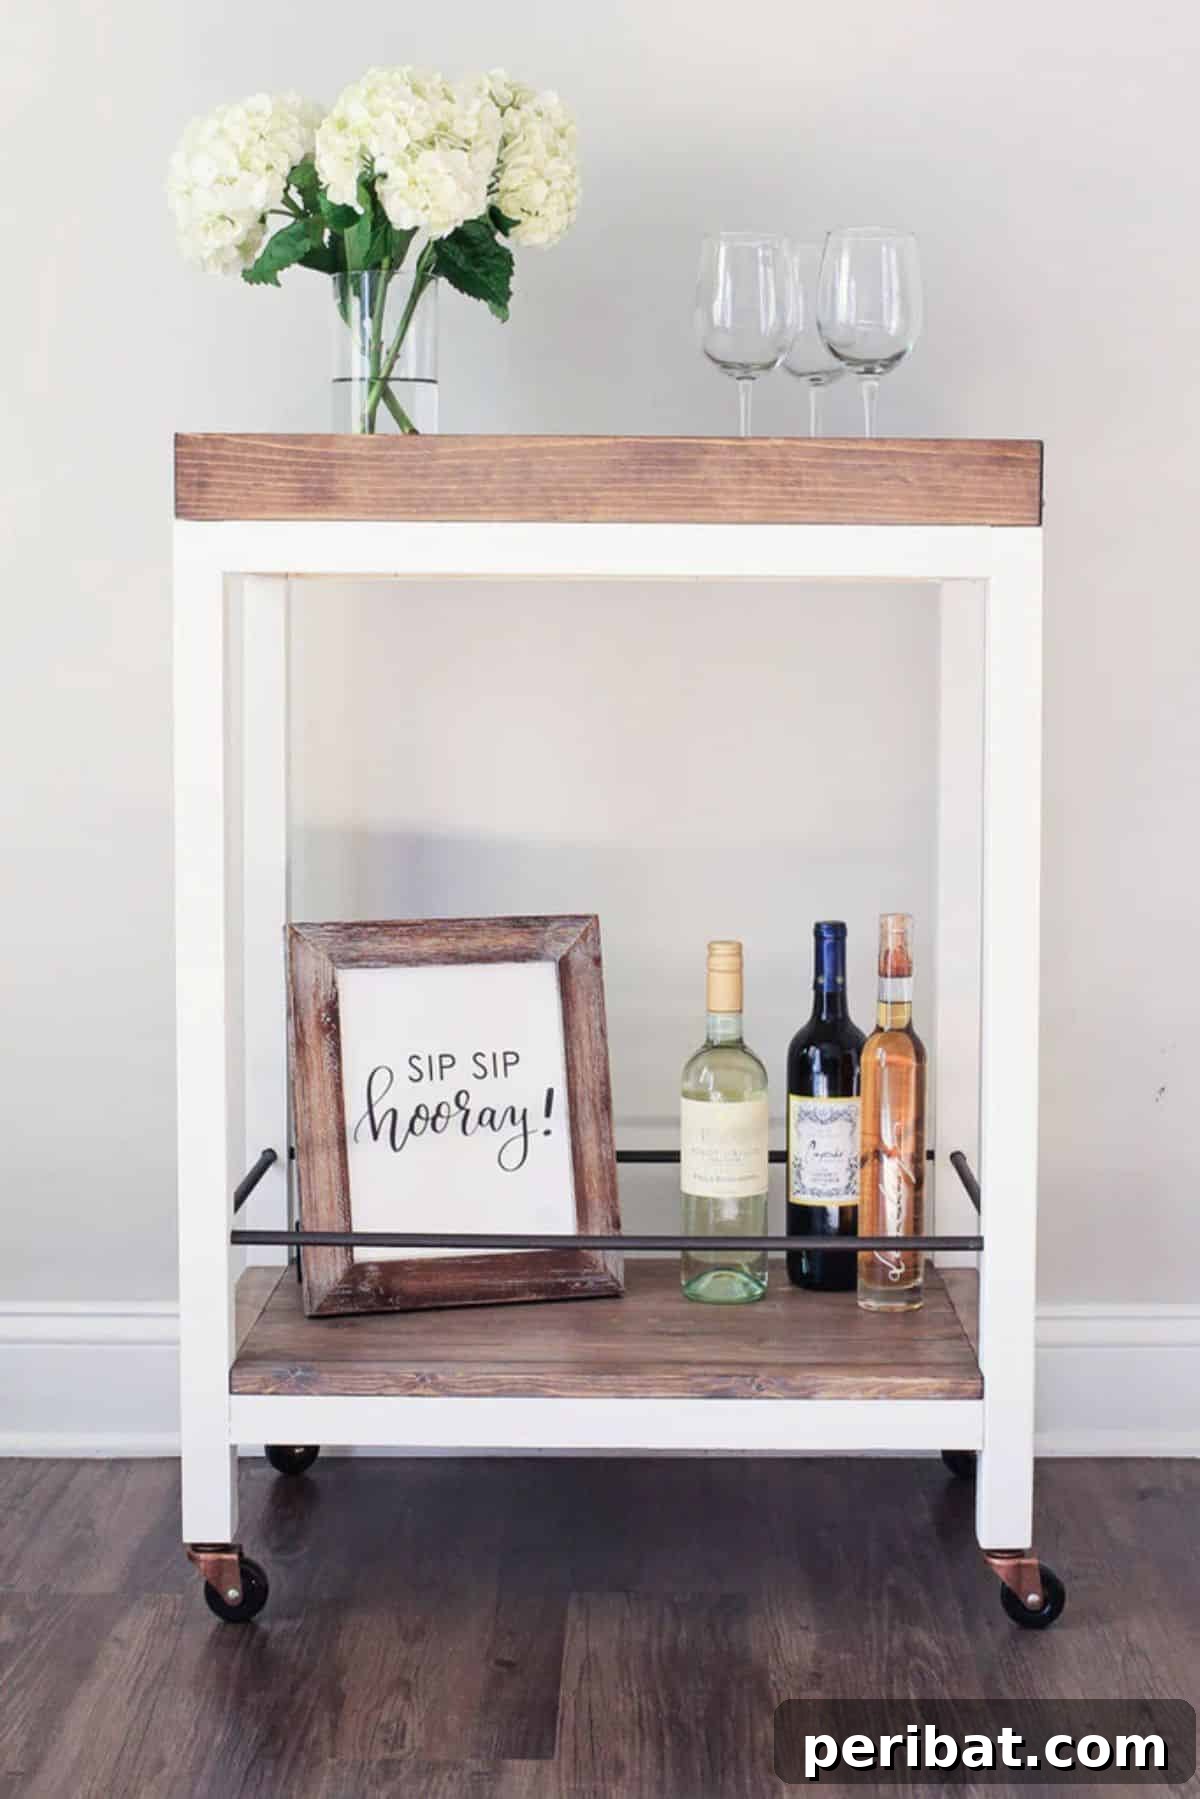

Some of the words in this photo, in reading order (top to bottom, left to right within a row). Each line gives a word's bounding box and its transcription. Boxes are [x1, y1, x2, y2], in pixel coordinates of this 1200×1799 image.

[408, 1053, 456, 1083] SIP
[472, 1051, 520, 1080] SIP
[353, 1065, 554, 1172] hooray!
